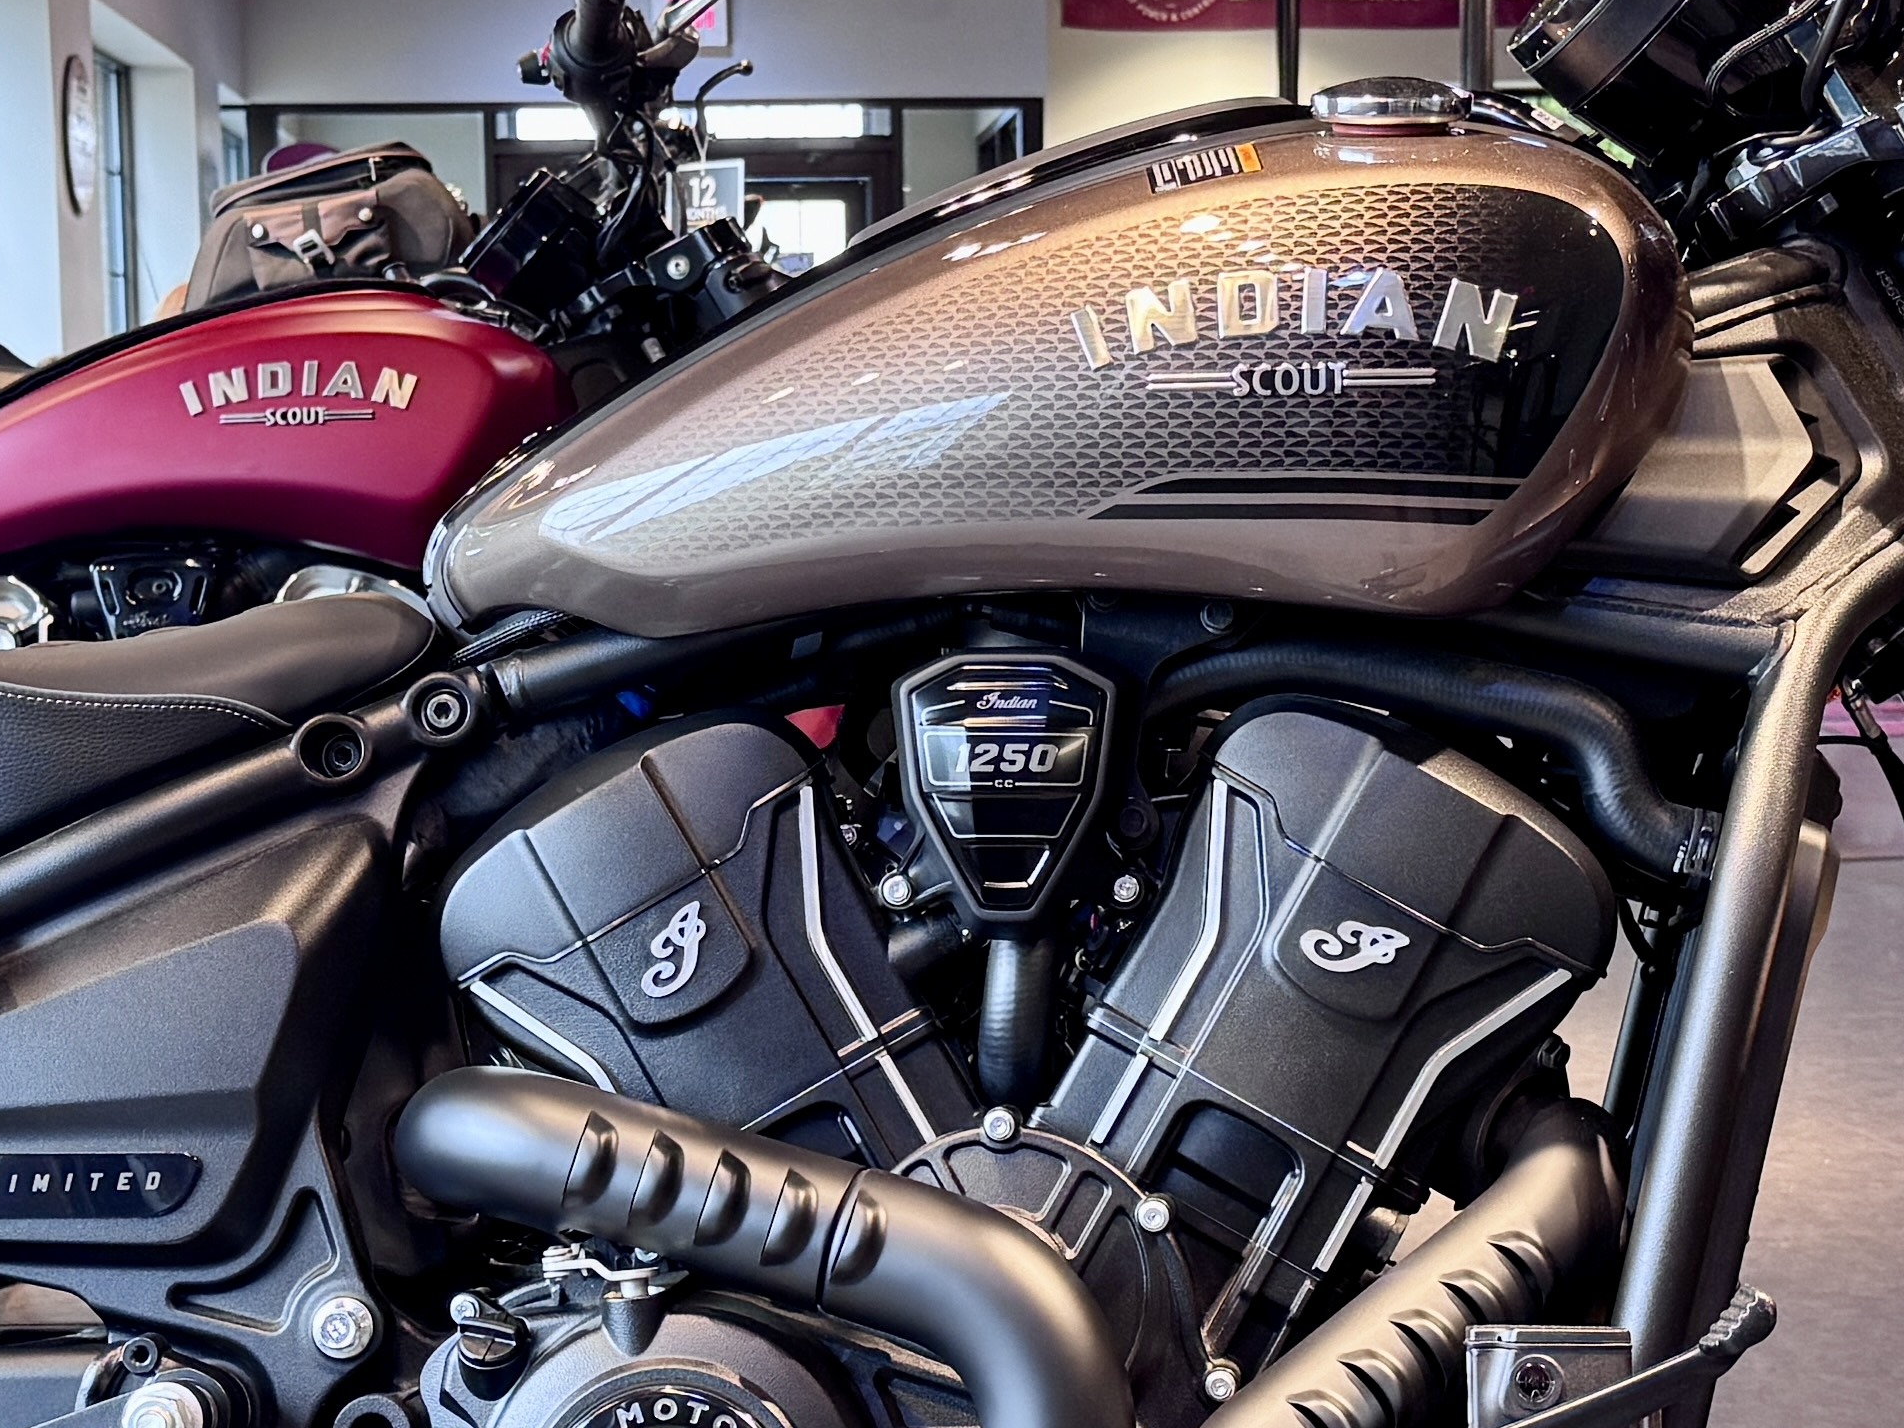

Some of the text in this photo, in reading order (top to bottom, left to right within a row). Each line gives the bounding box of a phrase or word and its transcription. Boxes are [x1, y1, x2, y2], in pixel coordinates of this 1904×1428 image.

[689, 175, 717, 208] 12
[1070, 267, 1518, 371] INDIAN
[179, 360, 418, 417] INDIAN
[1232, 361, 1347, 397] SCOUT
[265, 406, 327, 426] SCOUT
[976, 691, 1039, 710] Indian
[954, 743, 1059, 773] 1250
